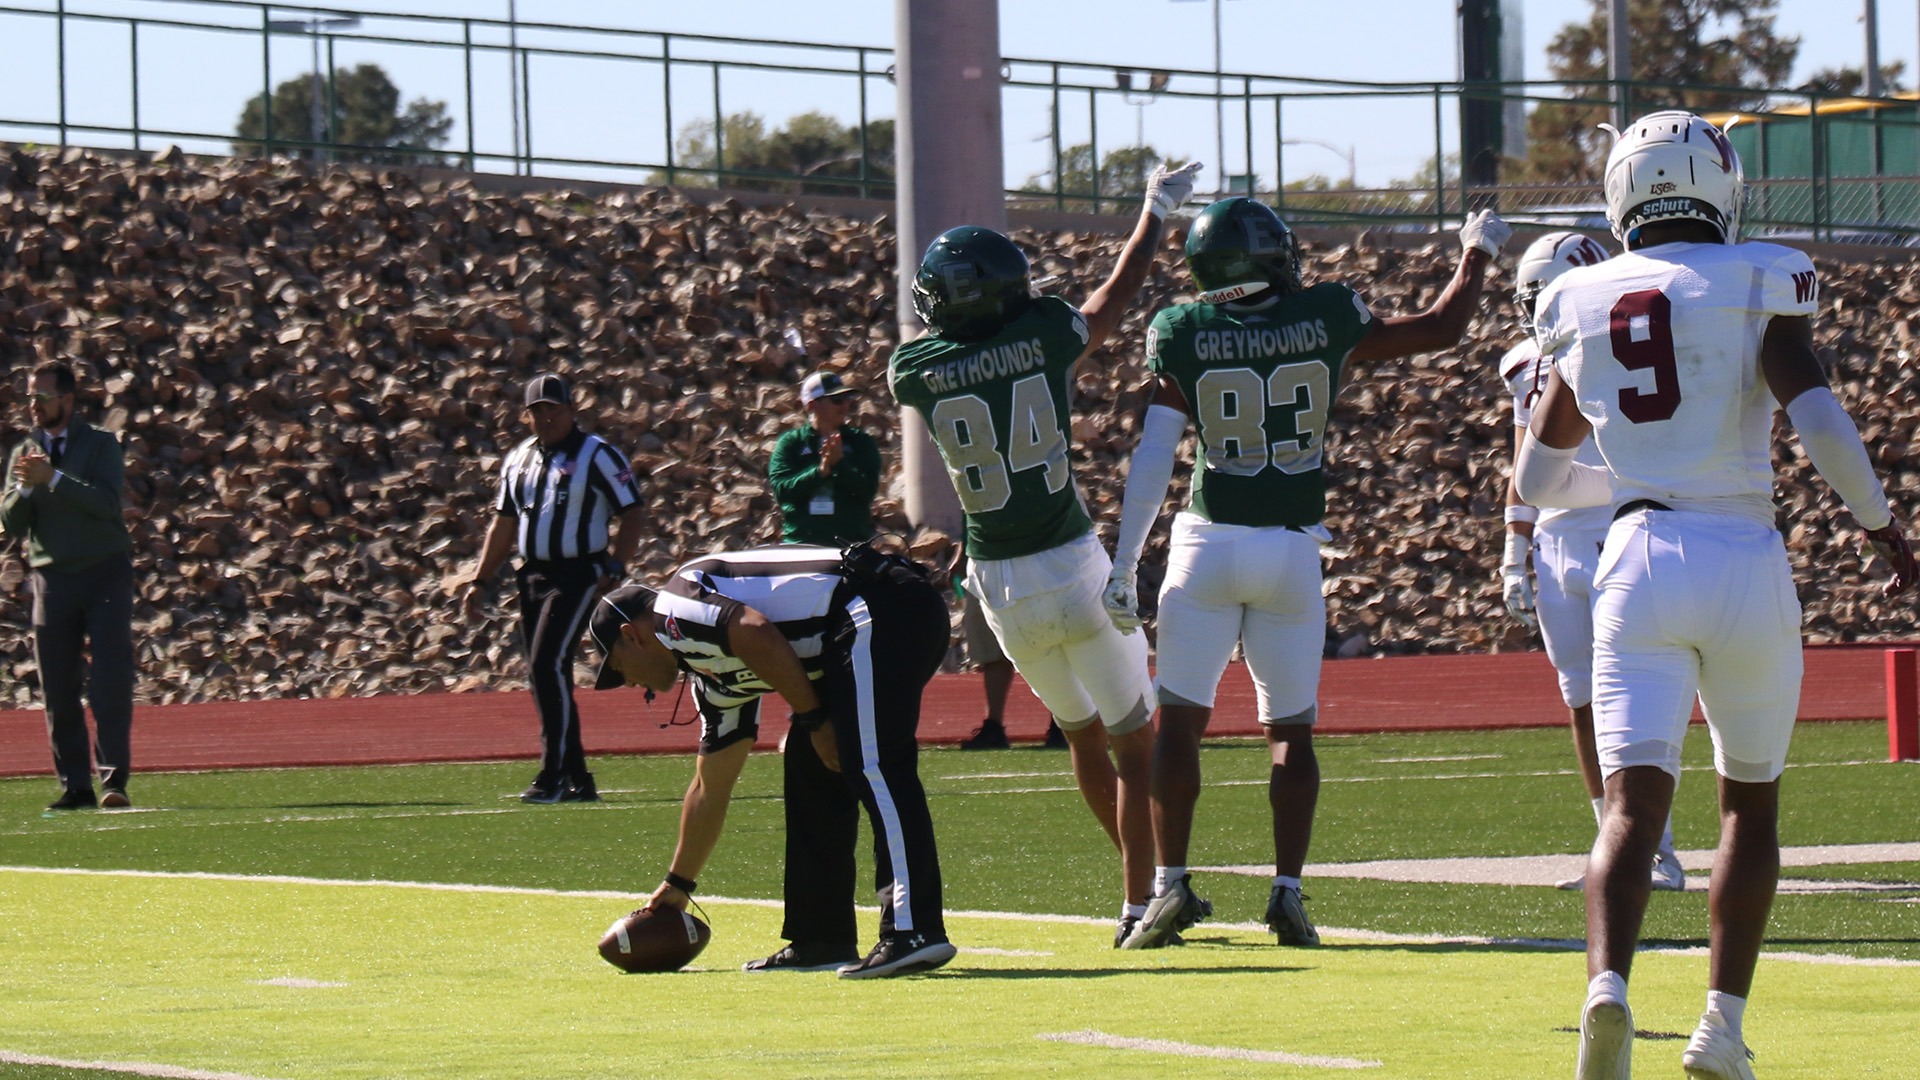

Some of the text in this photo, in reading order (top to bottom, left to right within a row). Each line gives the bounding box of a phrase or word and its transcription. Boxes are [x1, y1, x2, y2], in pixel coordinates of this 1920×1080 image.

[940, 261, 982, 305] E
[923, 337, 1046, 394] GREYHOUNDS
[1194, 318, 1329, 361] GREYHOUNDS
[1610, 288, 1682, 425] 9
[931, 373, 1070, 514] 84
[1196, 360, 1330, 477] 83
